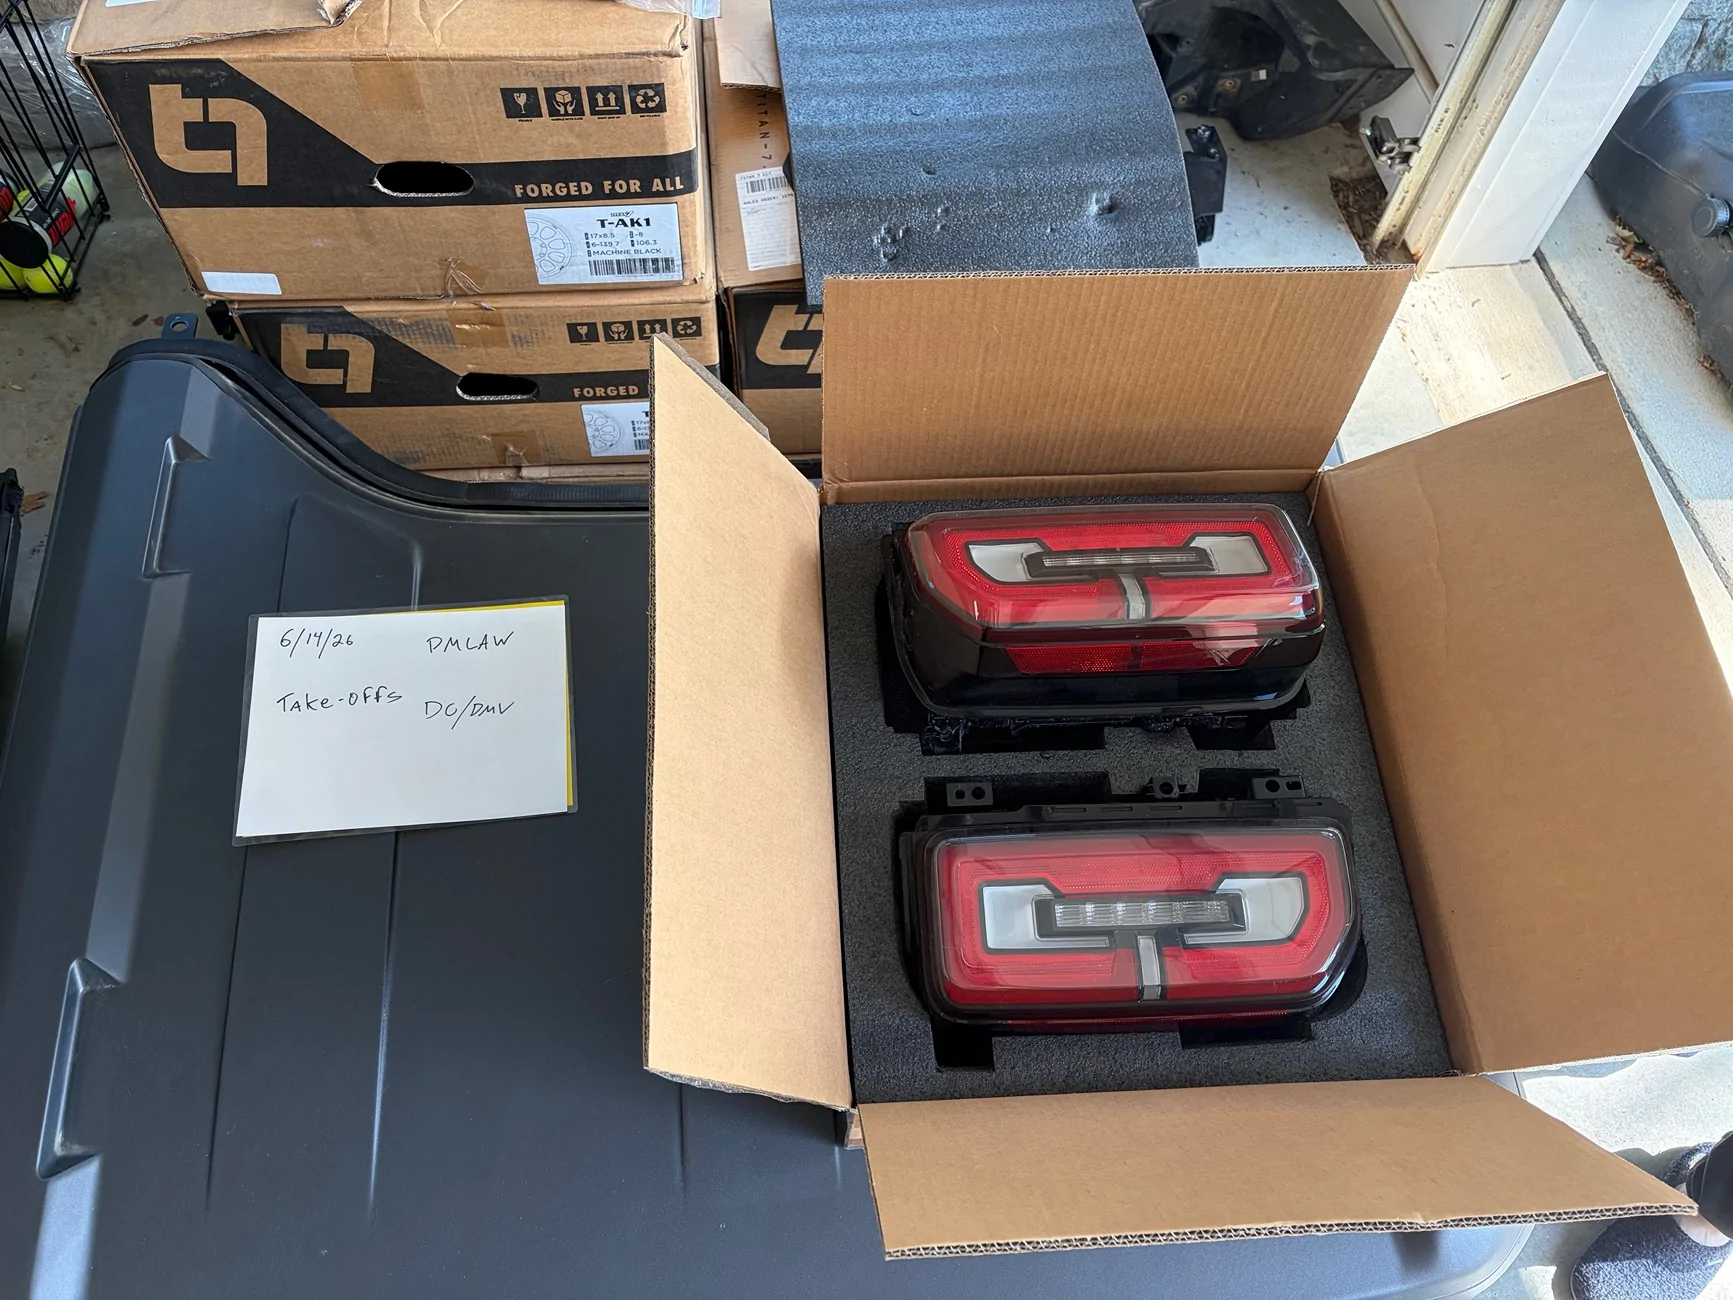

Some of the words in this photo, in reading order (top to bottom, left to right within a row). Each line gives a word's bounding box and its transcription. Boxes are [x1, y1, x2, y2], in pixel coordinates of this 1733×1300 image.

[514, 182, 593, 198] FORGED
[602, 179, 642, 194] FOR
[651, 176, 684, 192] ALL
[596, 217, 651, 228] T-AK1
[573, 385, 639, 398] FORGED
[280, 628, 354, 659] 6/14/26
[426, 631, 515, 654] DMLAW
